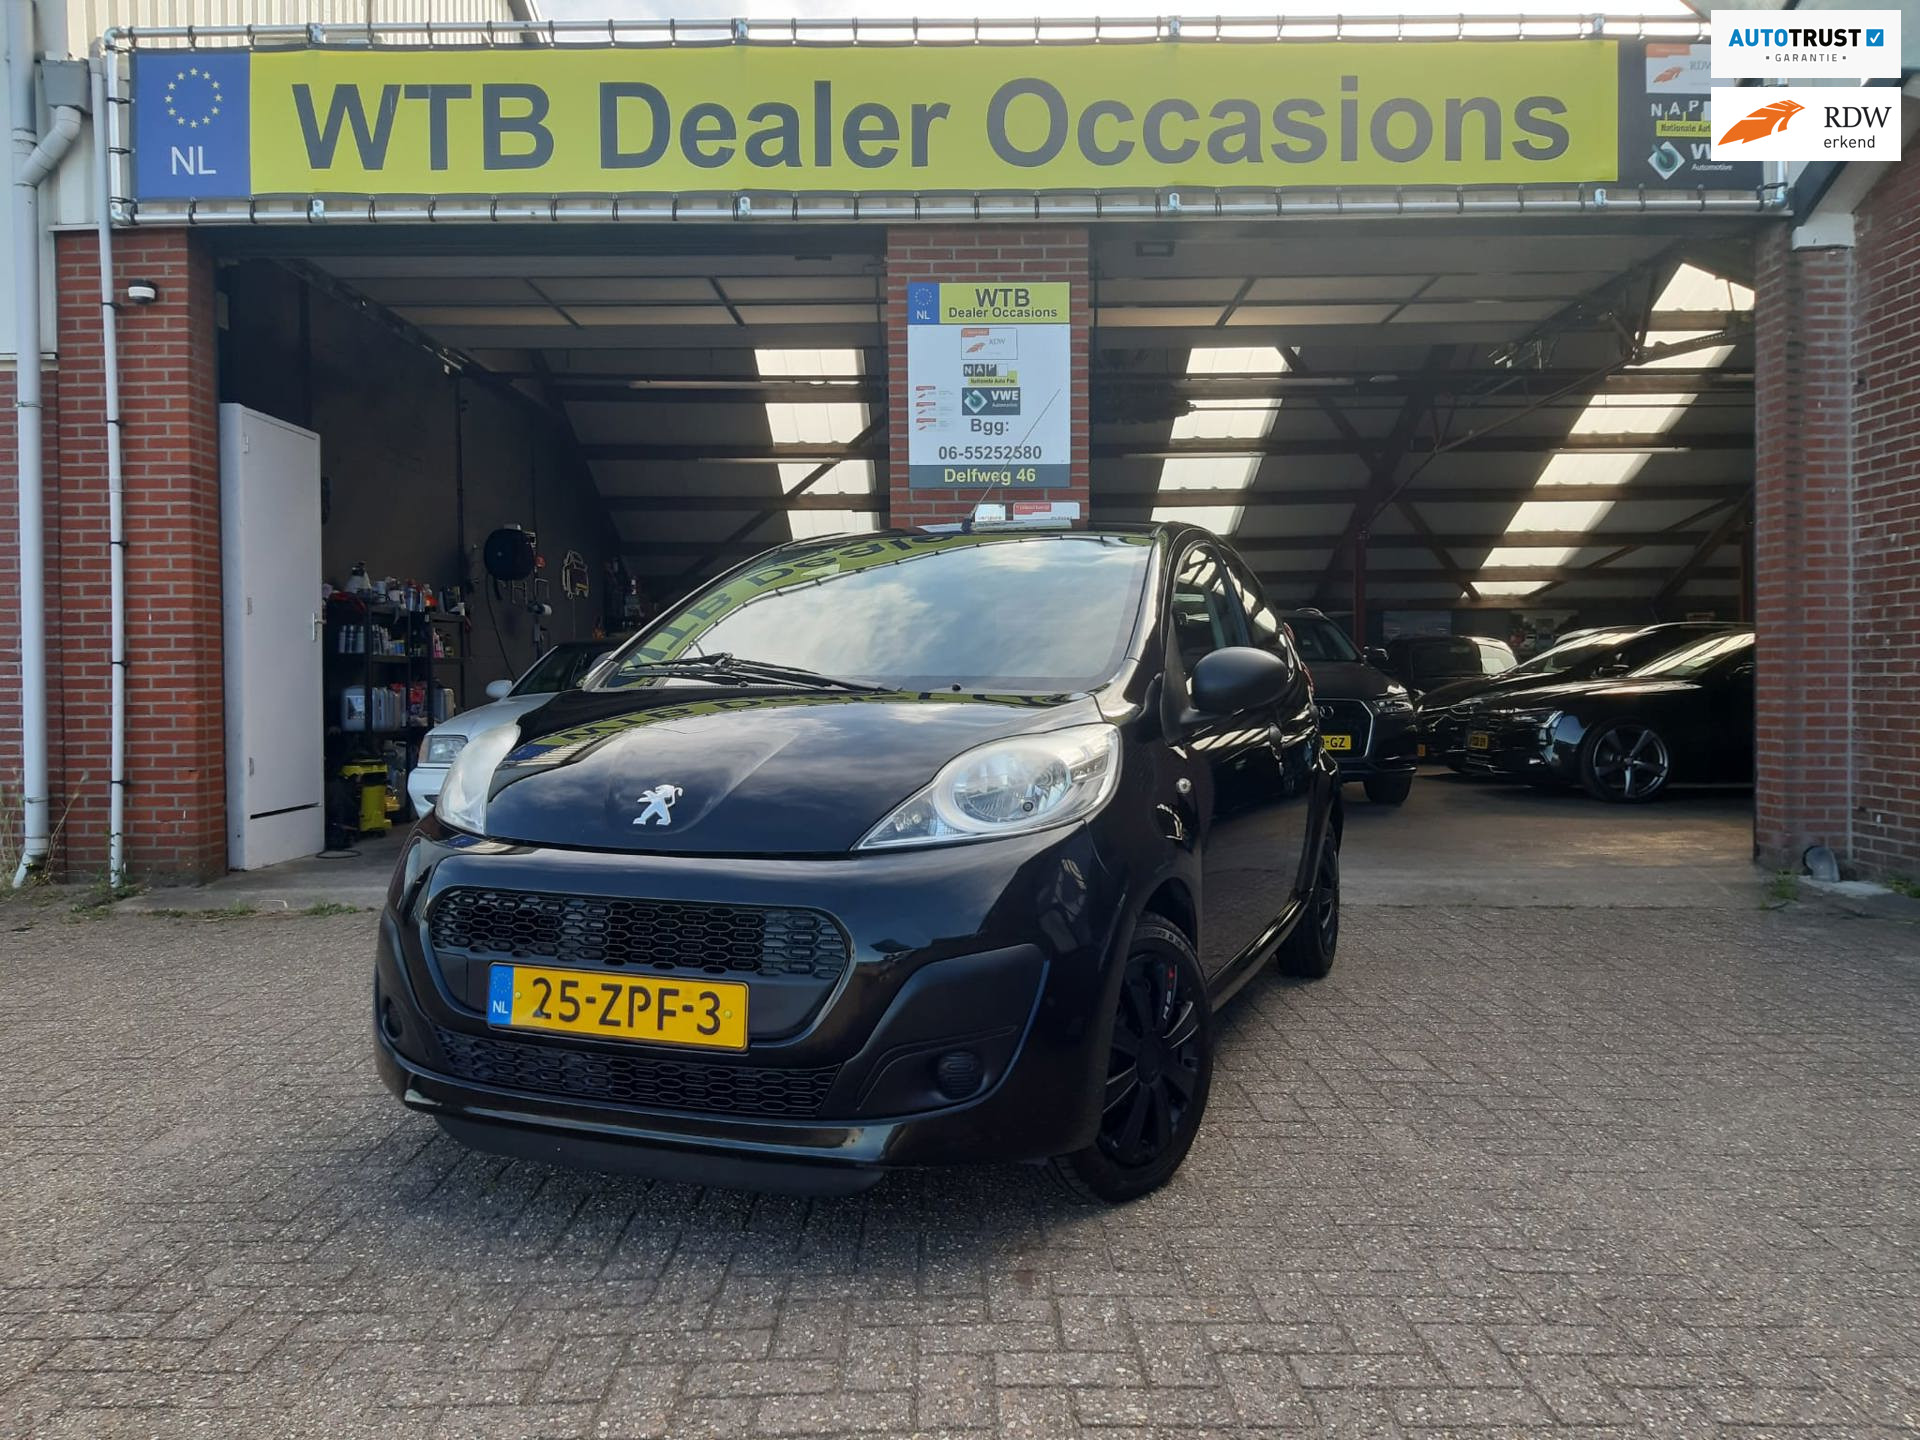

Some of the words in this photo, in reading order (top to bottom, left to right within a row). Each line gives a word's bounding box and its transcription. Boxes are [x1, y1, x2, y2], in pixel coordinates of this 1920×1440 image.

[291, 82, 555, 171] WTB
[599, 80, 950, 169] Dealer
[985, 75, 1570, 168] Occasions
[170, 146, 217, 175] NL
[974, 288, 1030, 308] WTB
[916, 310, 931, 320] NL
[948, 306, 989, 318] Dealer
[991, 306, 1058, 318] Occasions
[990, 390, 1019, 401] VWE
[970, 418, 1009, 435] Bgg:
[938, 445, 1042, 460] 06-55252580
[944, 468, 1012, 485] Delfweg
[1016, 468, 1036, 482] 46
[1322, 737, 1345, 748] -GZ
[492, 1000, 509, 1014] NL
[531, 977, 721, 1036] 25-ZPF-3
